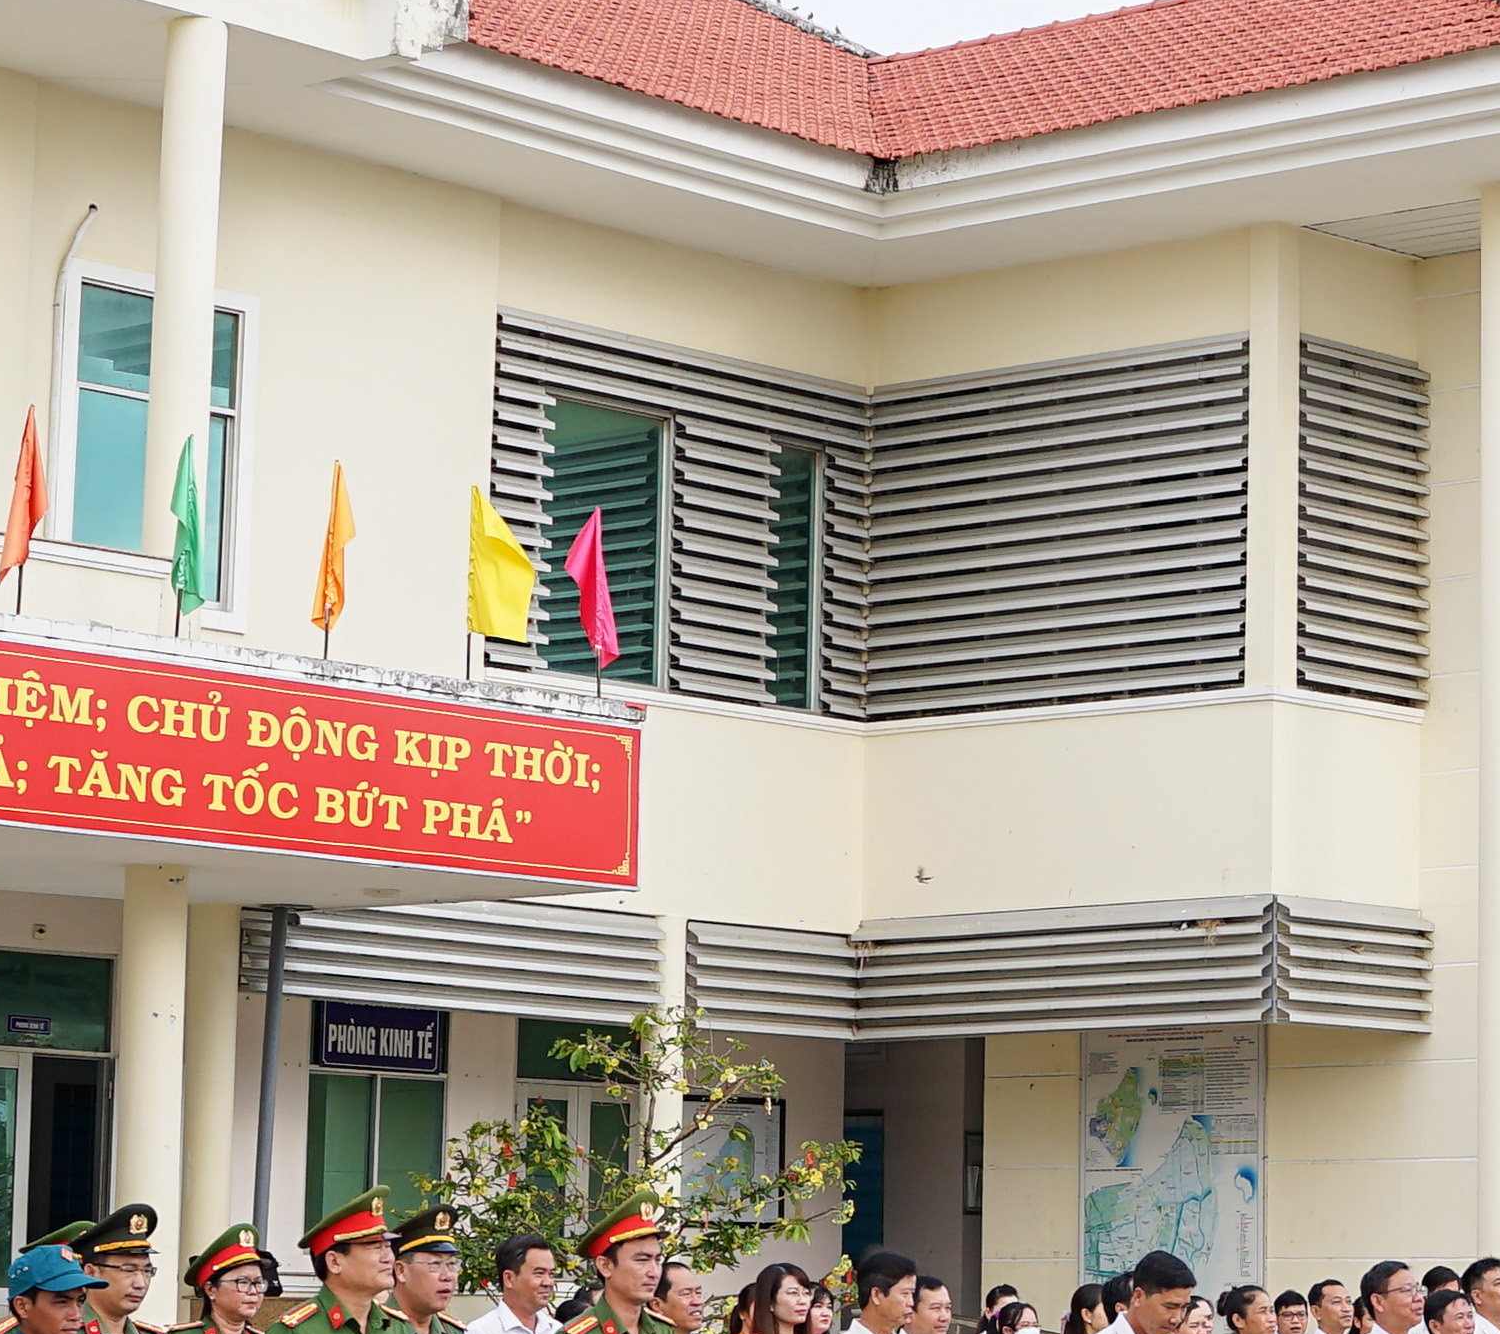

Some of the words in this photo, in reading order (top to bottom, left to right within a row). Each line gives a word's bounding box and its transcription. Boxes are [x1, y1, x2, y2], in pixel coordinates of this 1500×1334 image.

[128, 691, 230, 741] CHỦ
[247, 707, 379, 761] ĐỘNG
[394, 730, 471, 777] KỊP
[484, 741, 600, 793] THỜI;
[48, 750, 186, 806] TĂNG
[203, 763, 298, 818] TỐC
[314, 781, 408, 830] BỨT
[327, 1018, 377, 1056] PHÒNG
[379, 1028, 414, 1059] KINH
[417, 1022, 435, 1060] TẾ
